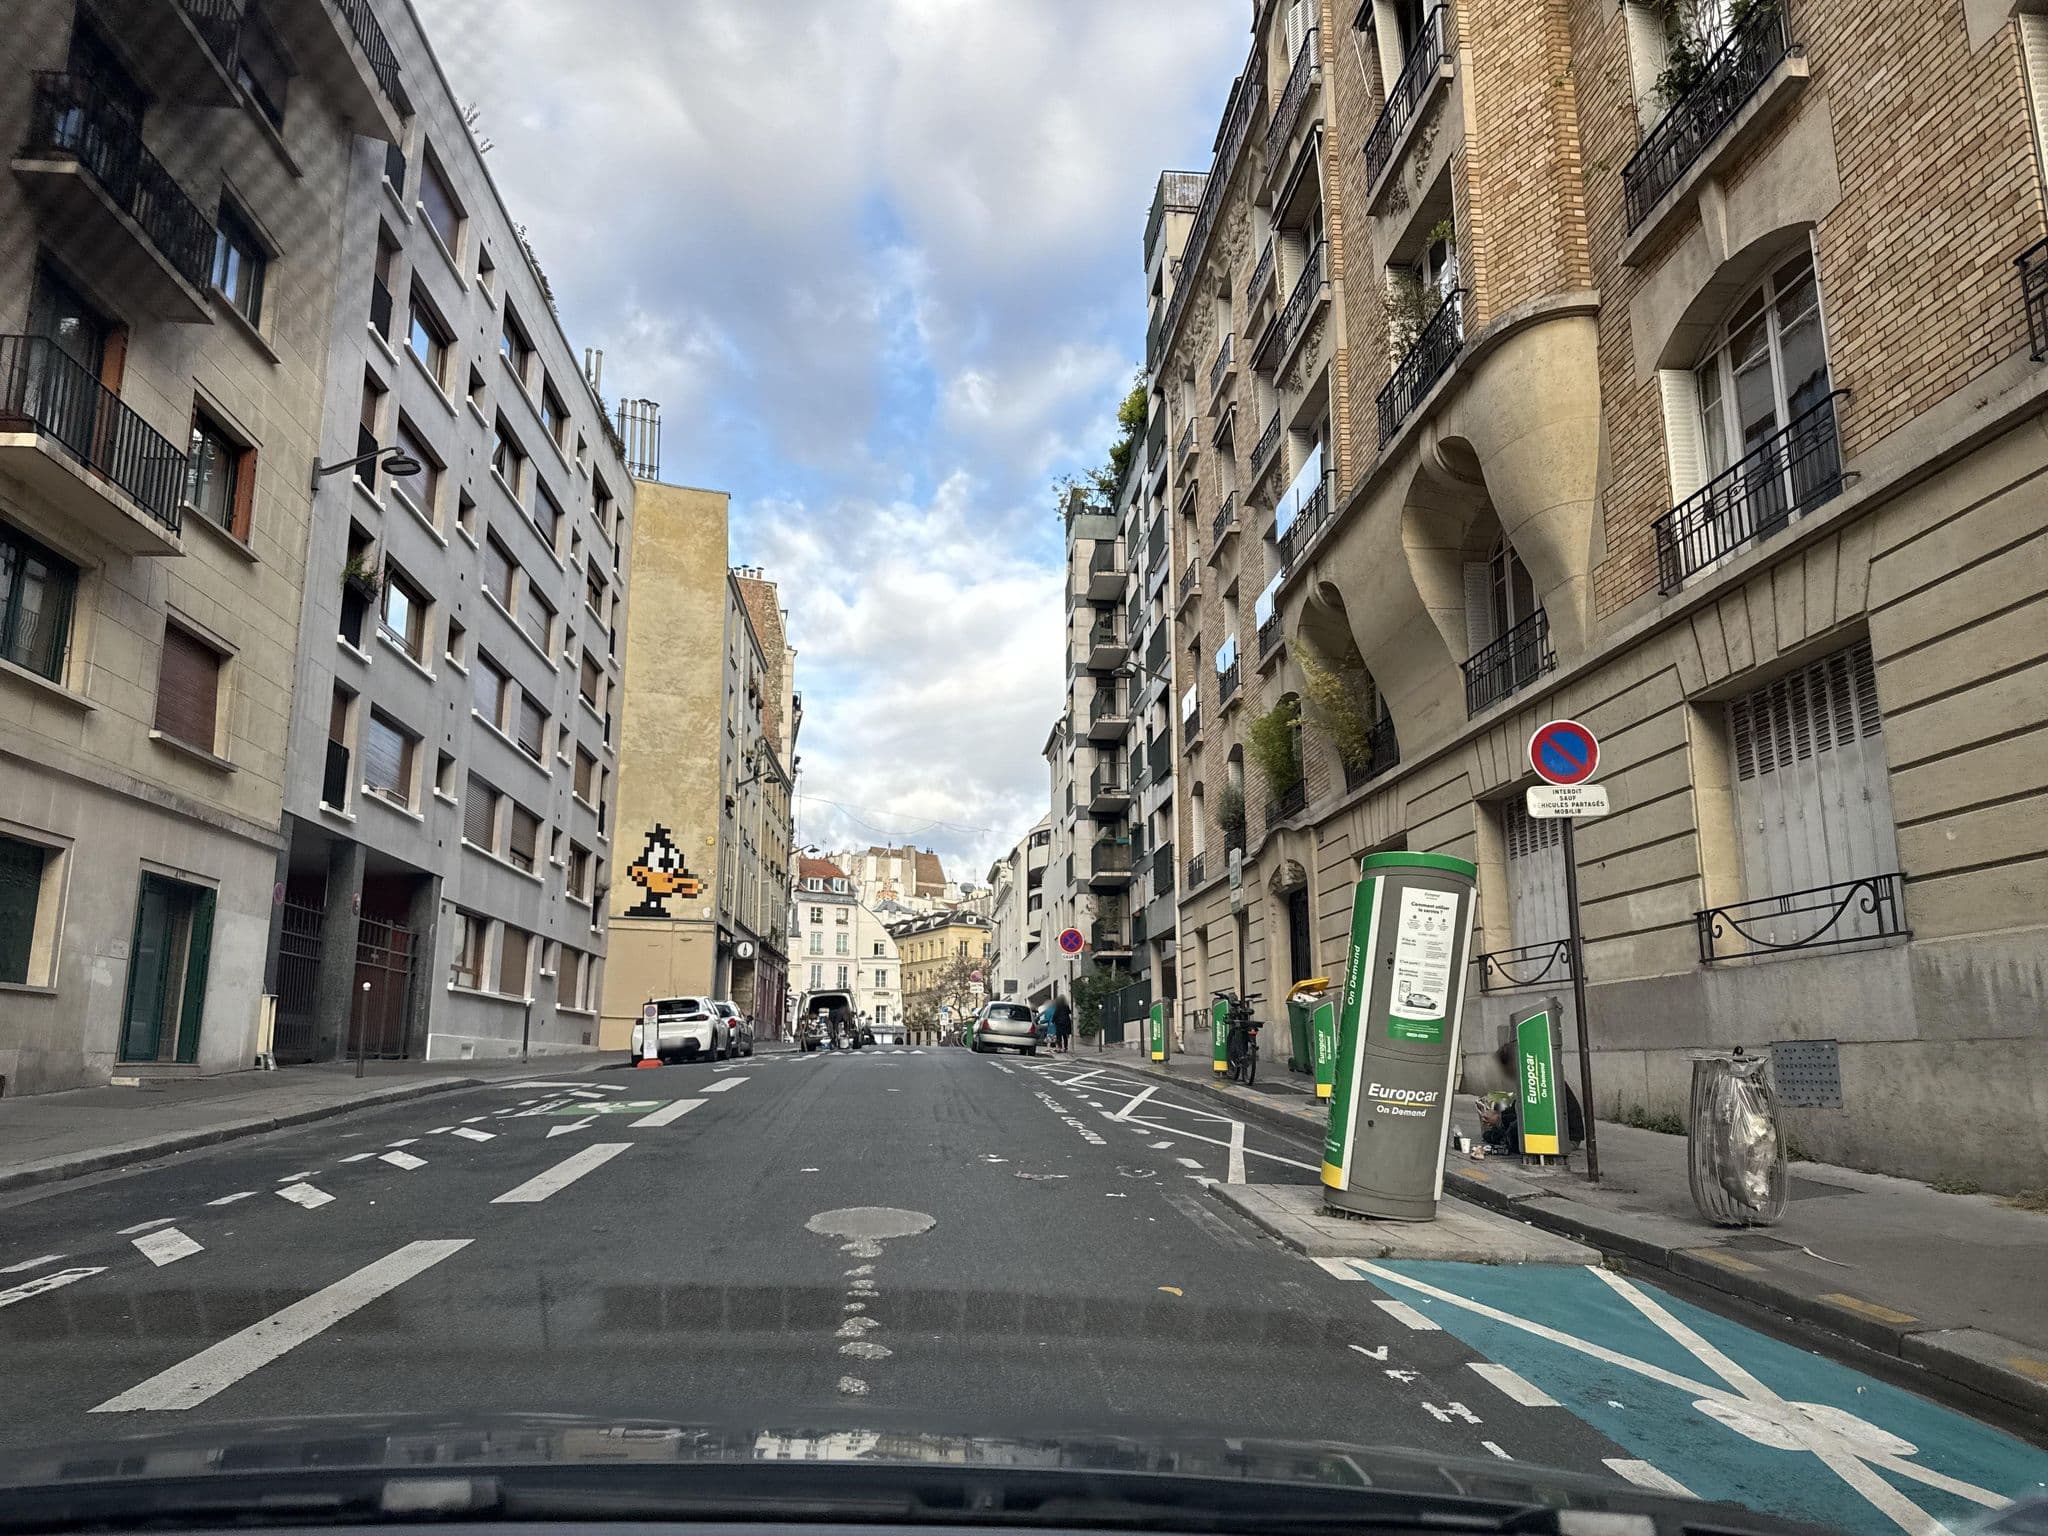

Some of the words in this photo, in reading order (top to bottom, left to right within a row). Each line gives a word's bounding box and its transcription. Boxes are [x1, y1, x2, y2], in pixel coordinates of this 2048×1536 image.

[1350, 944, 1361, 989] Demand
[1347, 990, 1355, 1006] On
[1526, 1053, 1538, 1105] Europcar
[1367, 1082, 1439, 1106] Europcar
[1376, 1104, 1390, 1114] On
[1391, 1106, 1427, 1117] Demand
